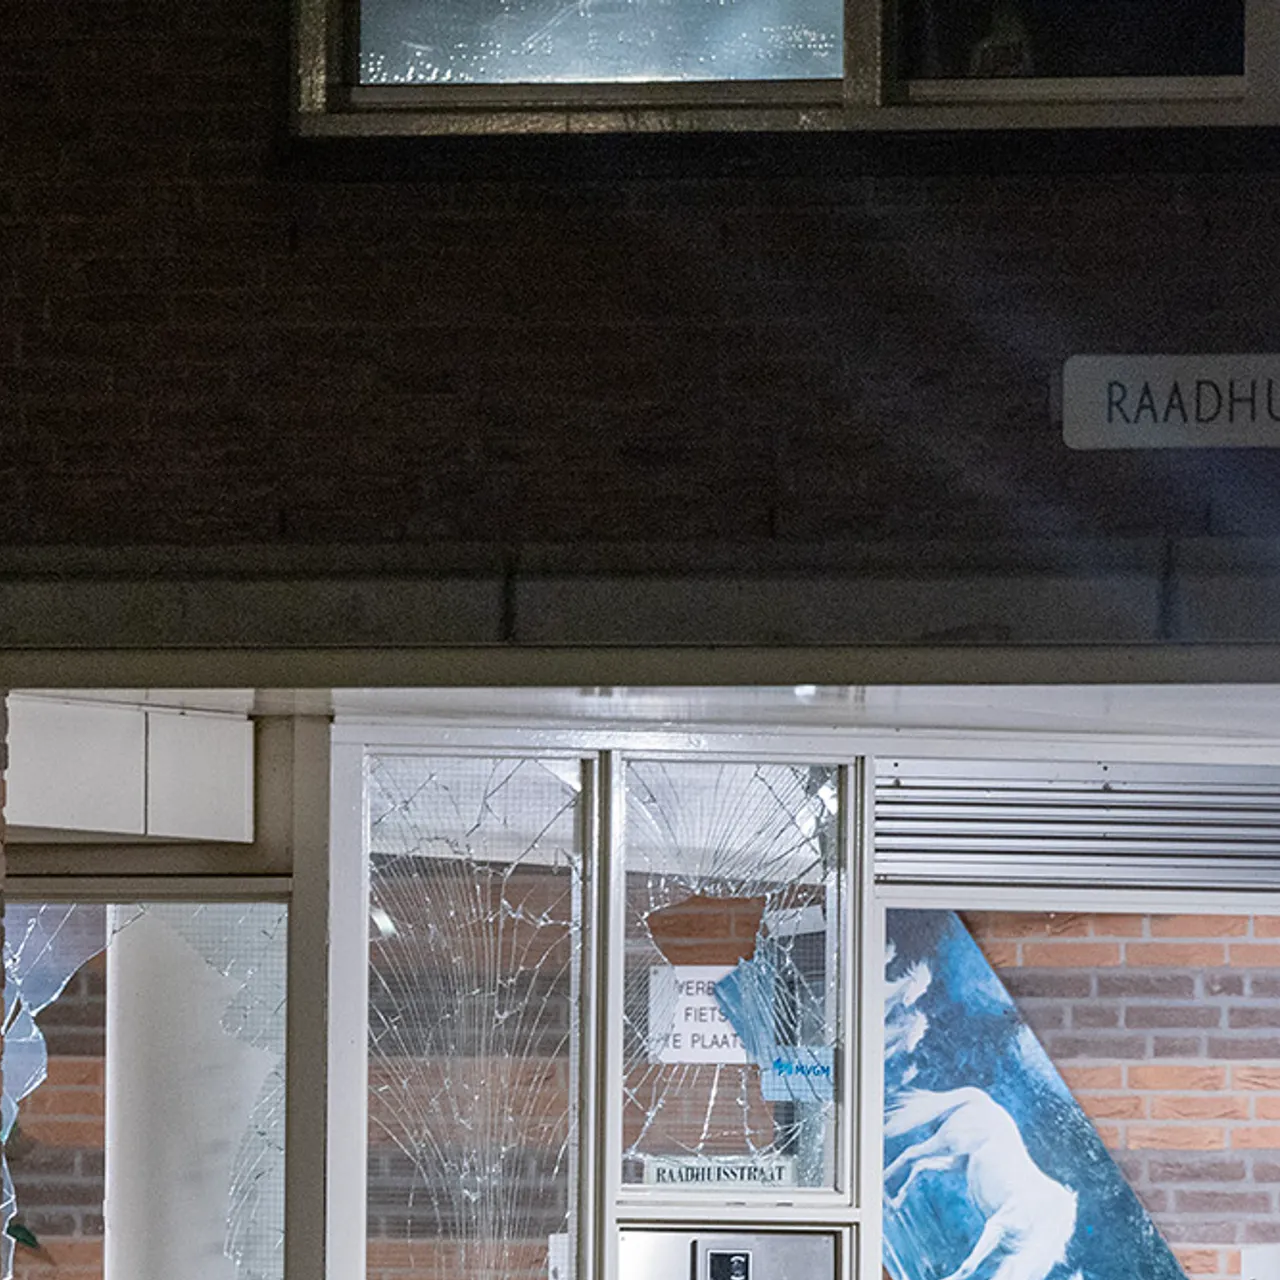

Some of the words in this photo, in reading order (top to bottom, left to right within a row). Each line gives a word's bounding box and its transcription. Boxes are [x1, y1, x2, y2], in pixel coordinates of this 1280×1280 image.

[674, 979, 716, 996] VERB
[684, 1006, 728, 1022] FIETS
[656, 1165, 786, 1183] RAADHUISSTRAAT
